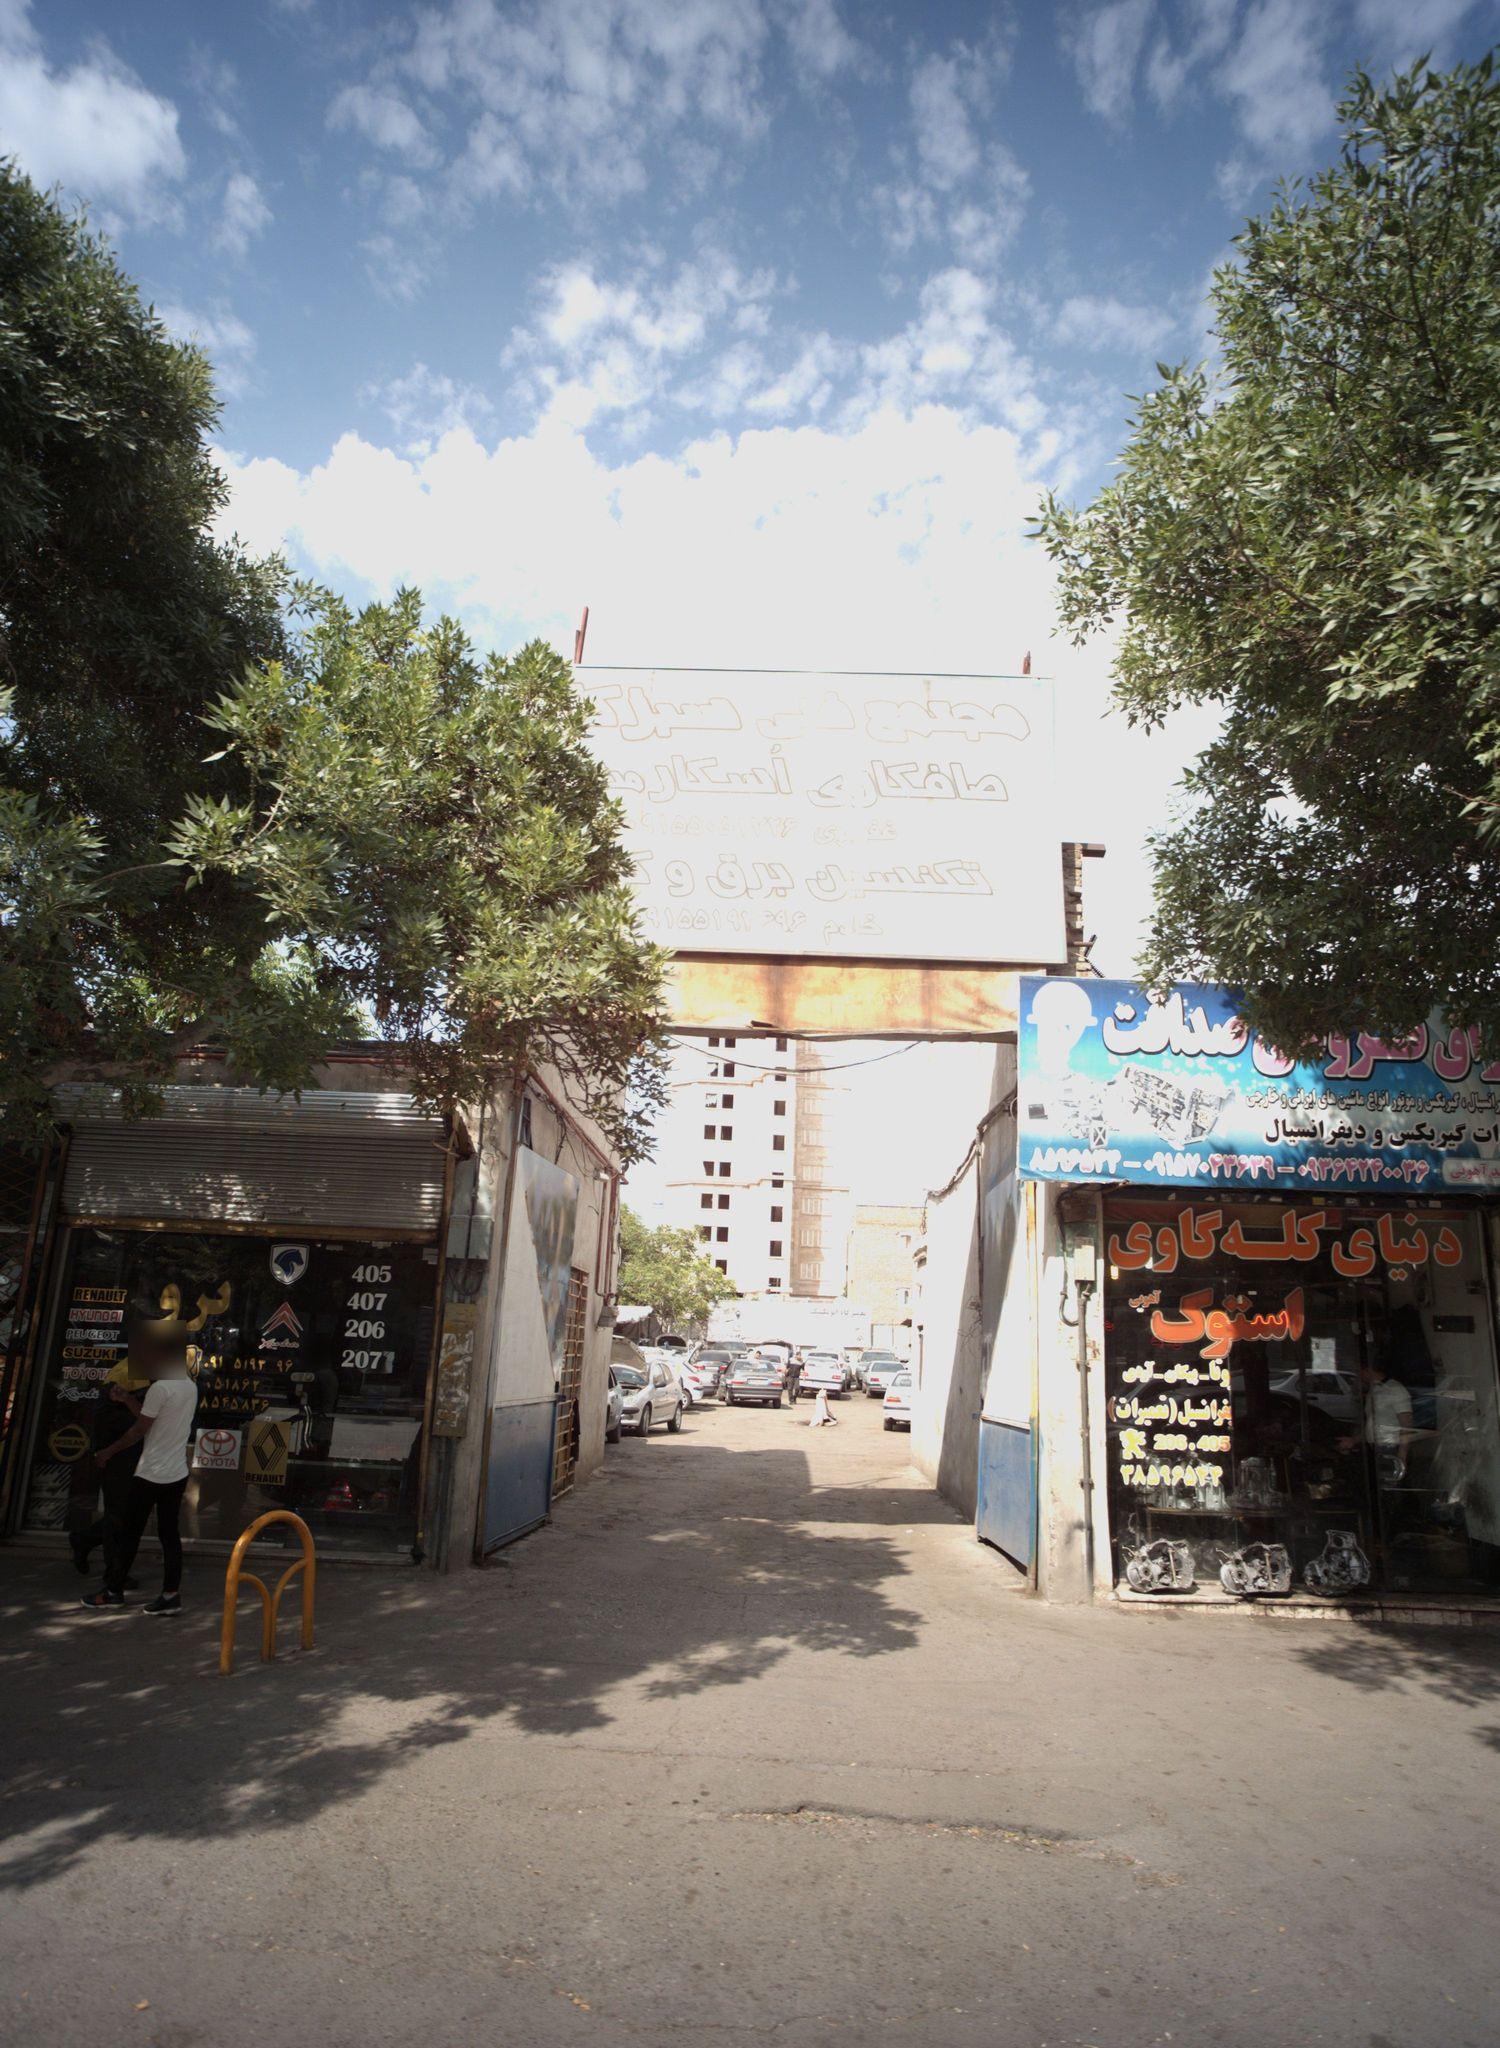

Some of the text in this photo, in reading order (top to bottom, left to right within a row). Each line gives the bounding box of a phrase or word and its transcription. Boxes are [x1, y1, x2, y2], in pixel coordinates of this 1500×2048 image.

[754, 687, 854, 741] فی
[804, 758, 1009, 807] صافکاری
[664, 858, 697, 897] و
[704, 852, 795, 899] برق
[803, 856, 993, 902] تکنسین
[1246, 1086, 1279, 1109] خارجی
[1288, 1086, 1317, 1110] ایرانی
[1318, 1087, 1338, 1110] های
[1338, 1088, 1365, 1110] ماشین
[1366, 1088, 1390, 1113] انواع
[1265, 1119, 1367, 1147] دیفرانسیال
[1371, 1128, 1384, 1148] و
[1389, 1121, 1467, 1149] گیربکس
[1107, 1206, 1463, 1282] دنیای کله گاوی
[352, 1264, 393, 1284] 405
[74, 1287, 127, 1303] RENAULT
[347, 1292, 388, 1312] 407
[69, 1308, 124, 1323] HYUNDAI
[1150, 1286, 1305, 1360] استوک
[66, 1329, 120, 1342] PEUGEOT
[344, 1319, 386, 1340] 206
[63, 1346, 118, 1361] SUZUKI
[195, 1456, 238, 1468] TOYOTA
[244, 1473, 286, 1484] RENAULT
